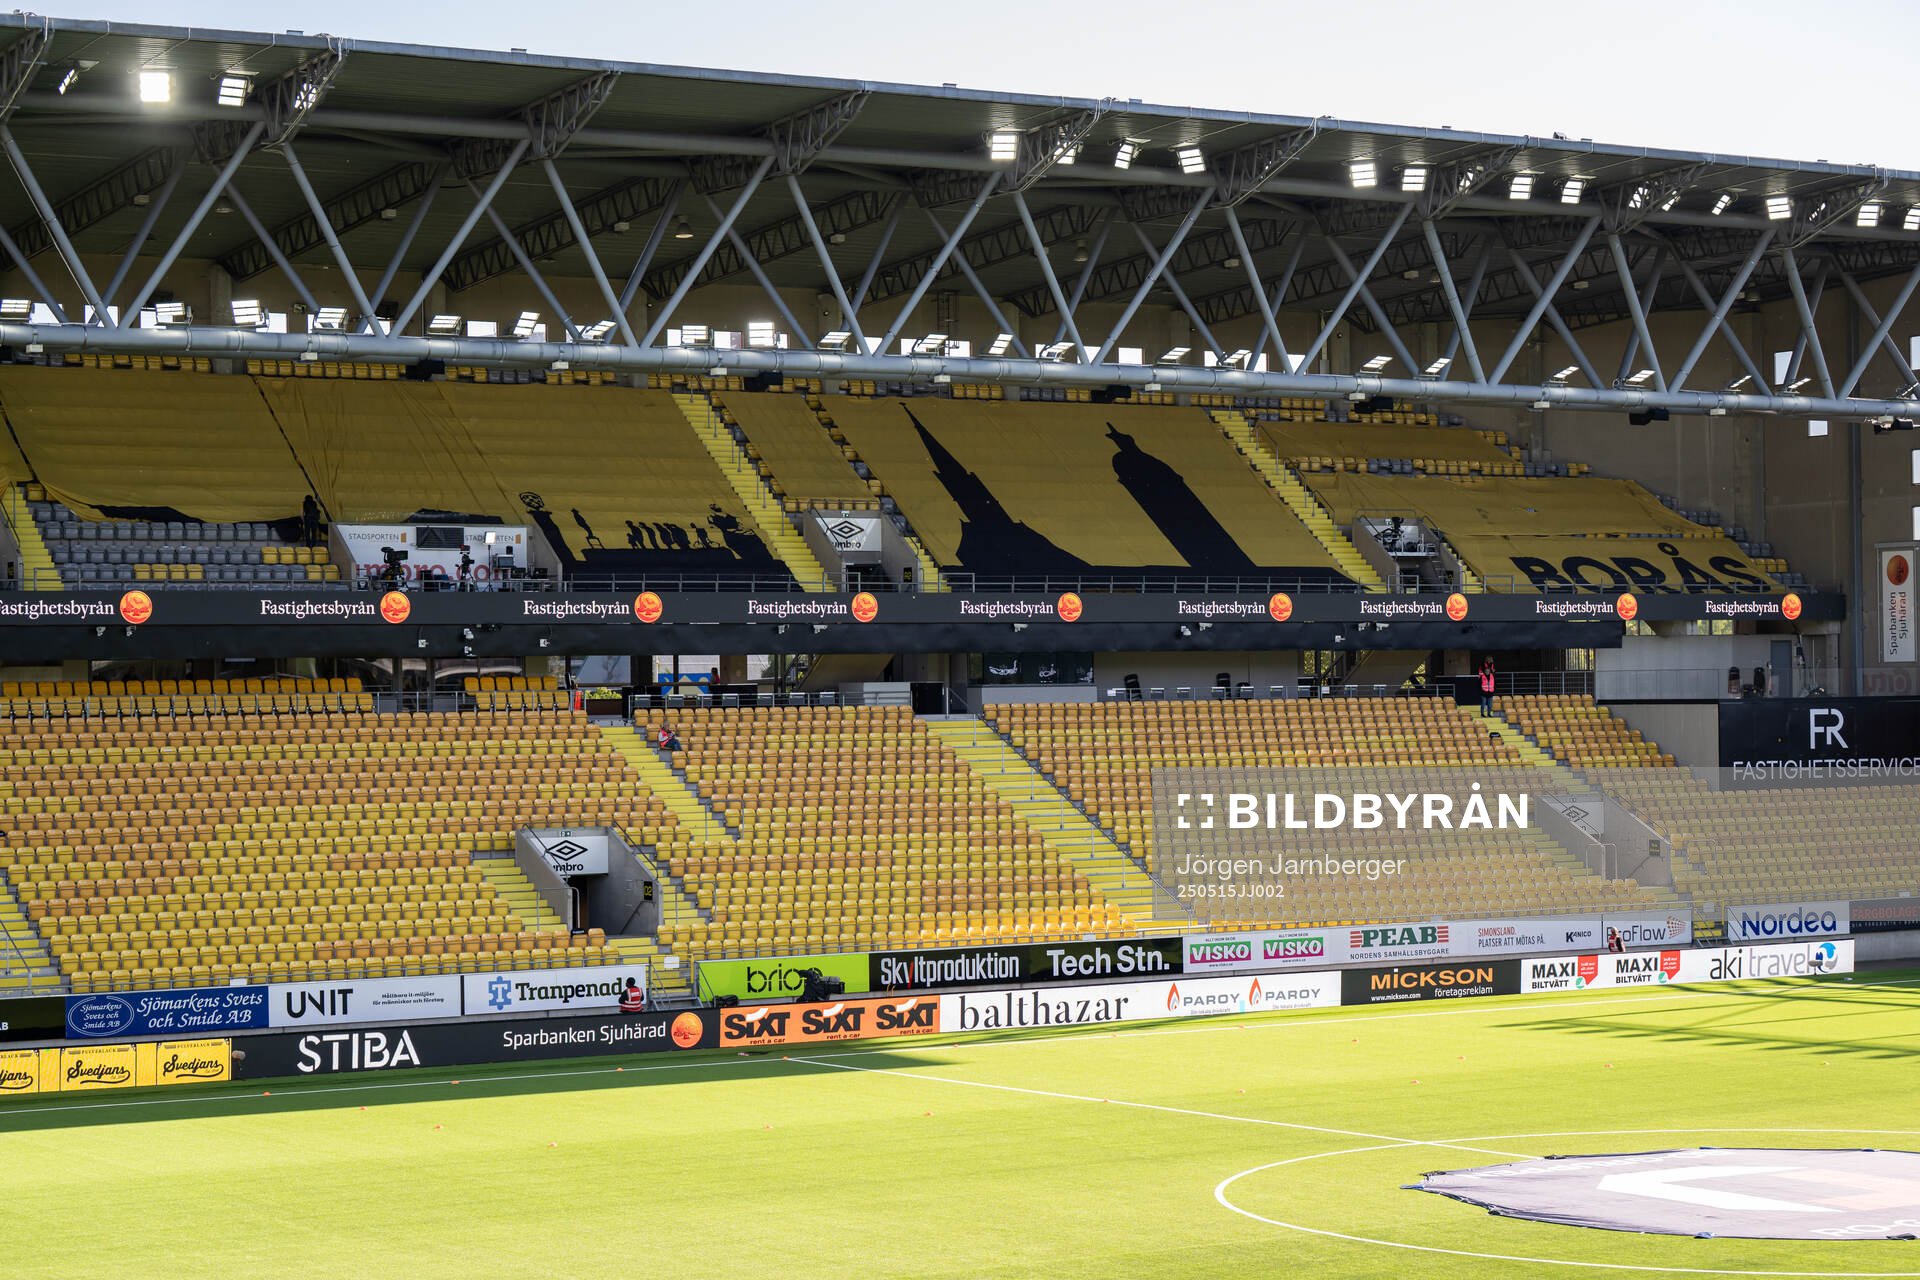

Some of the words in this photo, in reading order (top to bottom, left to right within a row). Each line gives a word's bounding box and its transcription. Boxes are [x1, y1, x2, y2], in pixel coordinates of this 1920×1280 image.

[348, 532, 399, 541] STADSPORTEN
[465, 533, 514, 542] STADRTEN
[1510, 542, 1772, 594] BORÅS
[0, 600, 115, 620] astighetsbyrån
[260, 600, 376, 619] Fastighetsbyrån
[523, 600, 630, 619] Fastighetsbyrån
[748, 600, 847, 619] Fastighetsbyrån
[960, 600, 1054, 618] Fastighetsbyrån
[1178, 600, 1266, 617] Fastighetsbyrån
[1360, 600, 1443, 617] Fastighetsbyrån
[1535, 600, 1614, 617] Fastighetsbyrån
[1705, 600, 1779, 617] Fastighetsbyrån
[1889, 591, 1899, 655] Sparbanken
[1809, 708, 1849, 750] FR
[553, 862, 584, 872] mbro
[1742, 907, 1837, 936] Nordea
[1361, 926, 1438, 947] PEAB
[1478, 938, 1503, 948] PLATSER
[1503, 937, 1514, 946] ATT
[1516, 935, 1536, 946] MÖTAS
[1191, 943, 1250, 961] VISKO
[1265, 939, 1322, 957] VISKO
[1350, 951, 1382, 960] NORDENS
[1383, 948, 1449, 958] SAMHÄLLSBYGGARE
[1046, 947, 1111, 977] Tech
[1116, 945, 1170, 973] Stn.
[1616, 957, 1658, 973] MAXI
[1709, 948, 1743, 980] aki
[1748, 944, 1811, 977] travel
[880, 952, 1020, 989] Skyltproduktion
[1532, 962, 1576, 979] MAXI
[1615, 974, 1652, 984] BILTVÄTT
[515, 977, 622, 1003] Tranpenad
[1531, 979, 1569, 989] BILTVÄTT
[1183, 993, 1240, 1006] PAROY
[1265, 988, 1321, 1001] PAROY
[1371, 993, 1421, 1001] www.mickson.com
[1434, 986, 1493, 997] företagsreklam
[80, 1002, 122, 1013] Sjömarkens
[136, 993, 220, 1017] Sjömarkens
[222, 993, 263, 1008] Svets
[286, 988, 354, 1018] UNIT
[959, 990, 1129, 1030] balthazar
[82, 1021, 106, 1029] Smide
[107, 1020, 121, 1028] AB
[148, 1012, 174, 1028] och
[177, 1009, 223, 1028] Smide
[225, 1009, 252, 1023] AB
[503, 1029, 596, 1050] Sparbanken
[600, 1021, 667, 1045] Sjuhärad
[296, 1029, 421, 1073] STIBA
[66, 1060, 131, 1084] Svedjans
[163, 1054, 224, 1078] Svedjans
